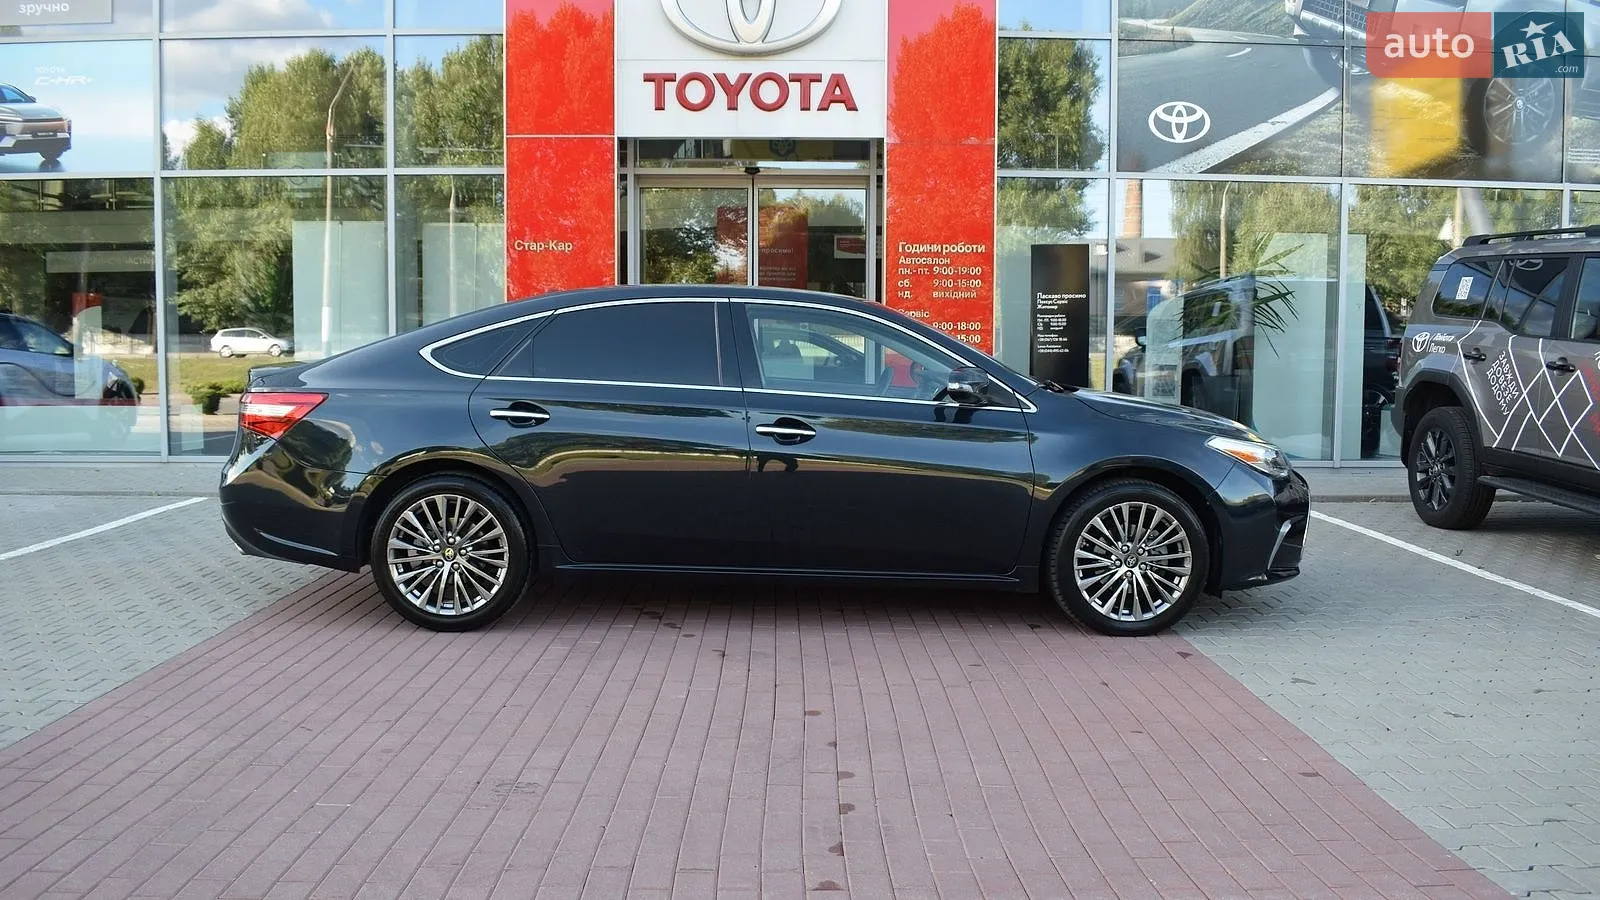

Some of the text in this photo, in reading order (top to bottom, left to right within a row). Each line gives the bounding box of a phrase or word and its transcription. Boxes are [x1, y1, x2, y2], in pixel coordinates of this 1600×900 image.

[18, 2, 70, 16] зручно
[643, 71, 859, 112] TOYOTA
[514, 239, 573, 253] Стар-Кар
[898, 241, 986, 255] Години роботи
[898, 255, 951, 265] Автосалон
[897, 278, 913, 288] сб.
[898, 289, 977, 299] нд. вихідний
[1491, 360, 1513, 403] ДОВЕЗЕ
[1499, 350, 1519, 399] ЗАВЖДИ
[1486, 369, 1510, 416] ДОДОМУ
